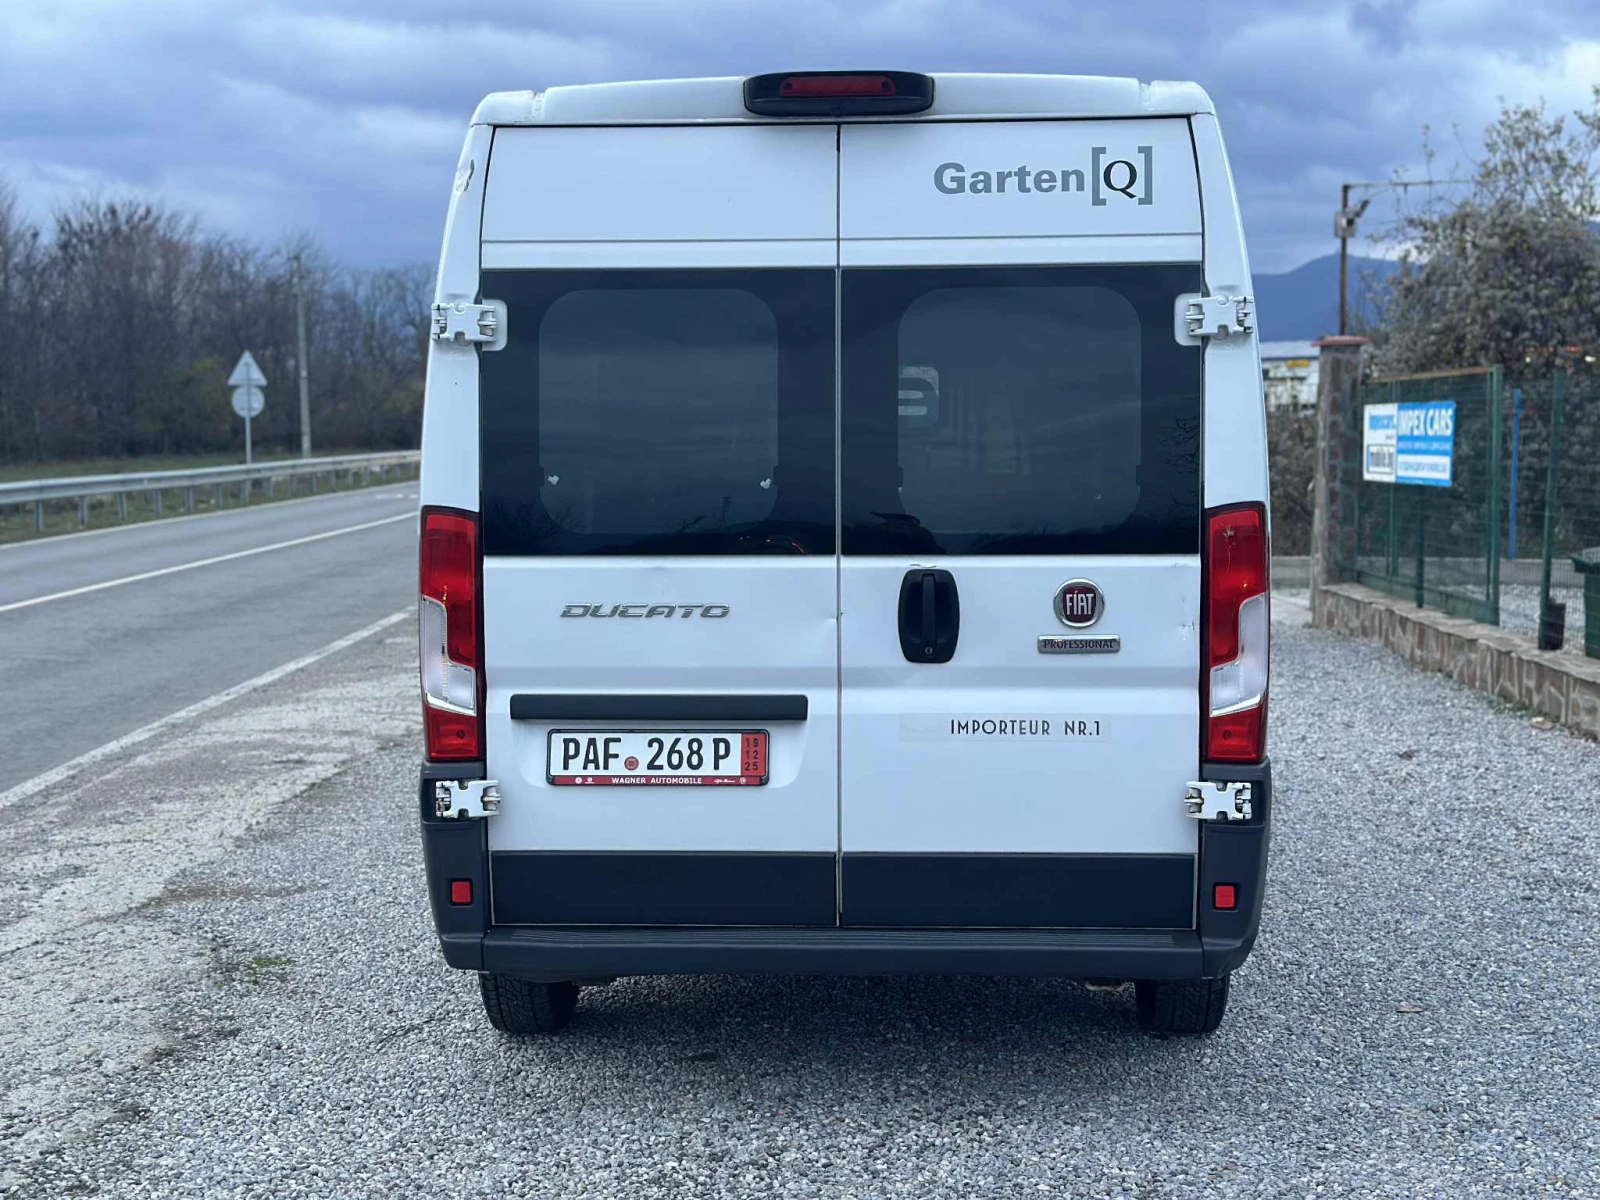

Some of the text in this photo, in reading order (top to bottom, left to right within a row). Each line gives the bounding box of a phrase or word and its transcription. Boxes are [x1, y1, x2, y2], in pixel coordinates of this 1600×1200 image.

[1398, 409, 1426, 436] IMPEX
[1426, 408, 1454, 437] CARS
[560, 602, 730, 619] DUCATO
[1065, 590, 1094, 616] FIAT
[1043, 639, 1114, 650] PROFESSIONAL
[950, 719, 1100, 736] IMPORTEUR NR.1
[562, 737, 731, 771] PAF 268 P
[744, 761, 759, 771] 25
[611, 776, 646, 785] WAGNER
[650, 776, 703, 785] AUTOMOBILE
